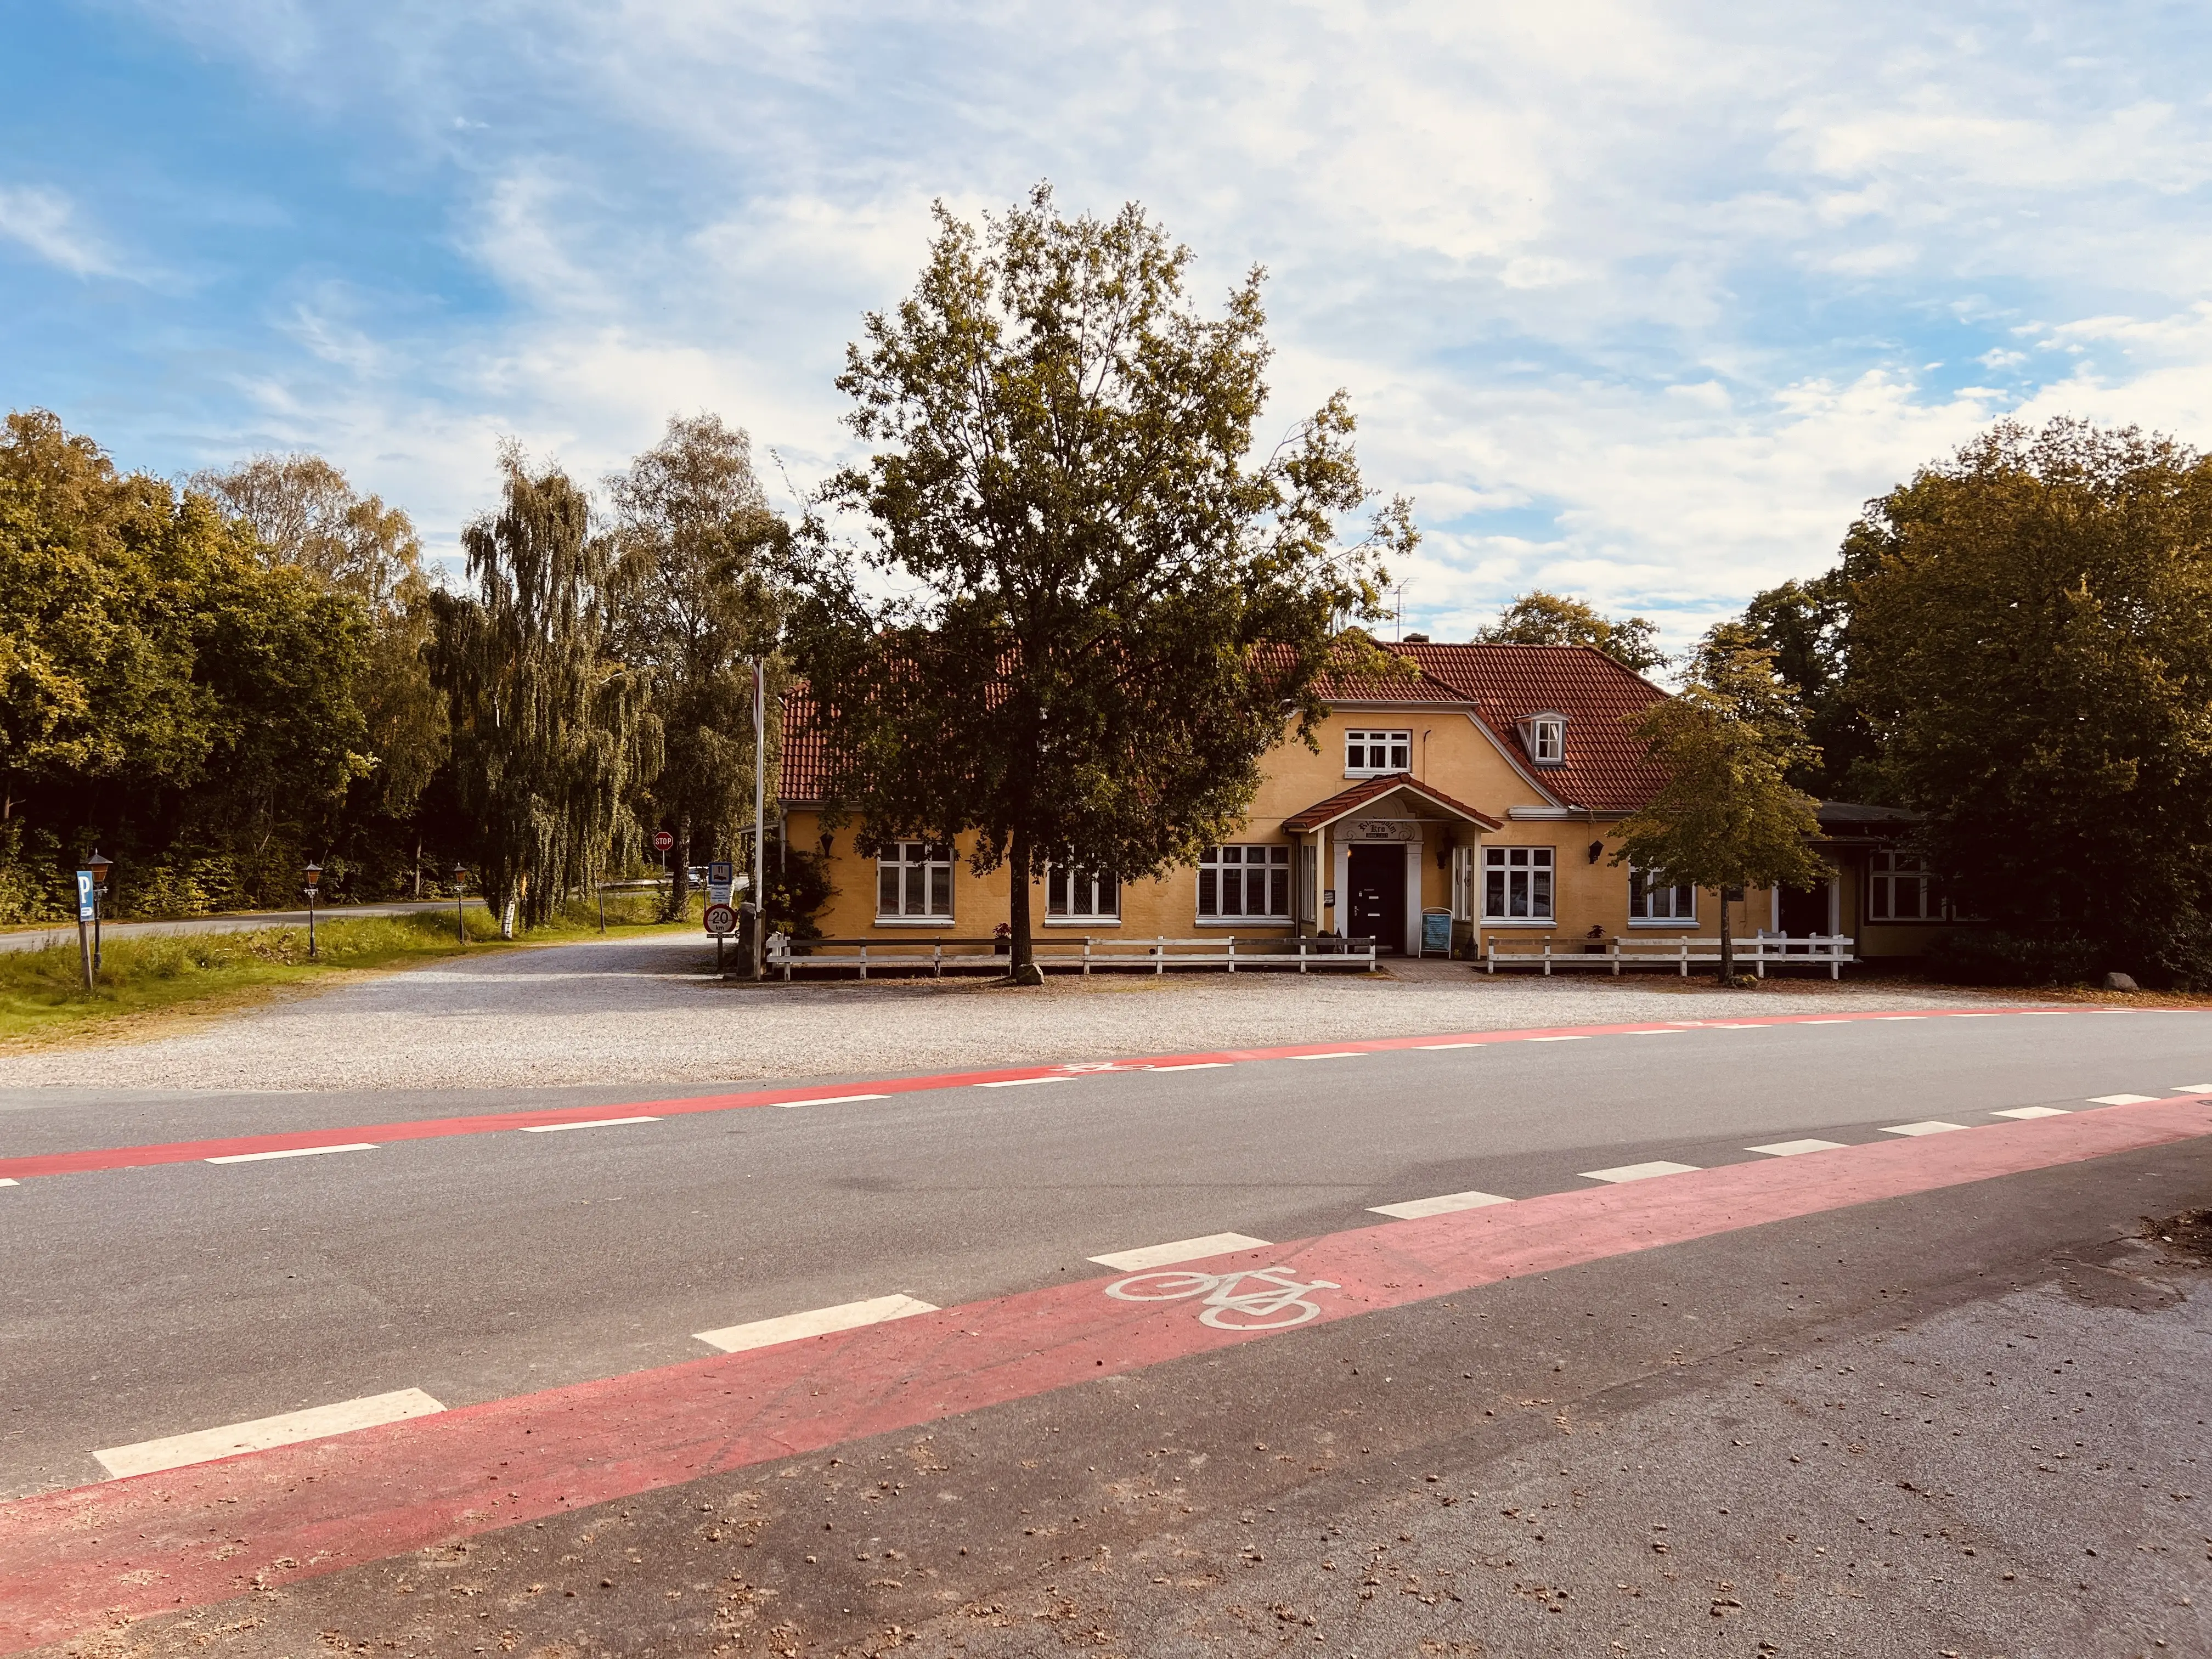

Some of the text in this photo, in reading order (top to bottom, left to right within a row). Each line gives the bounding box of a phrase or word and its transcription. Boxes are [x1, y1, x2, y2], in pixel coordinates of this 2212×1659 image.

[1370, 825, 1385, 833] Kro
[78, 876, 90, 904] P
[712, 911, 729, 924] 20
